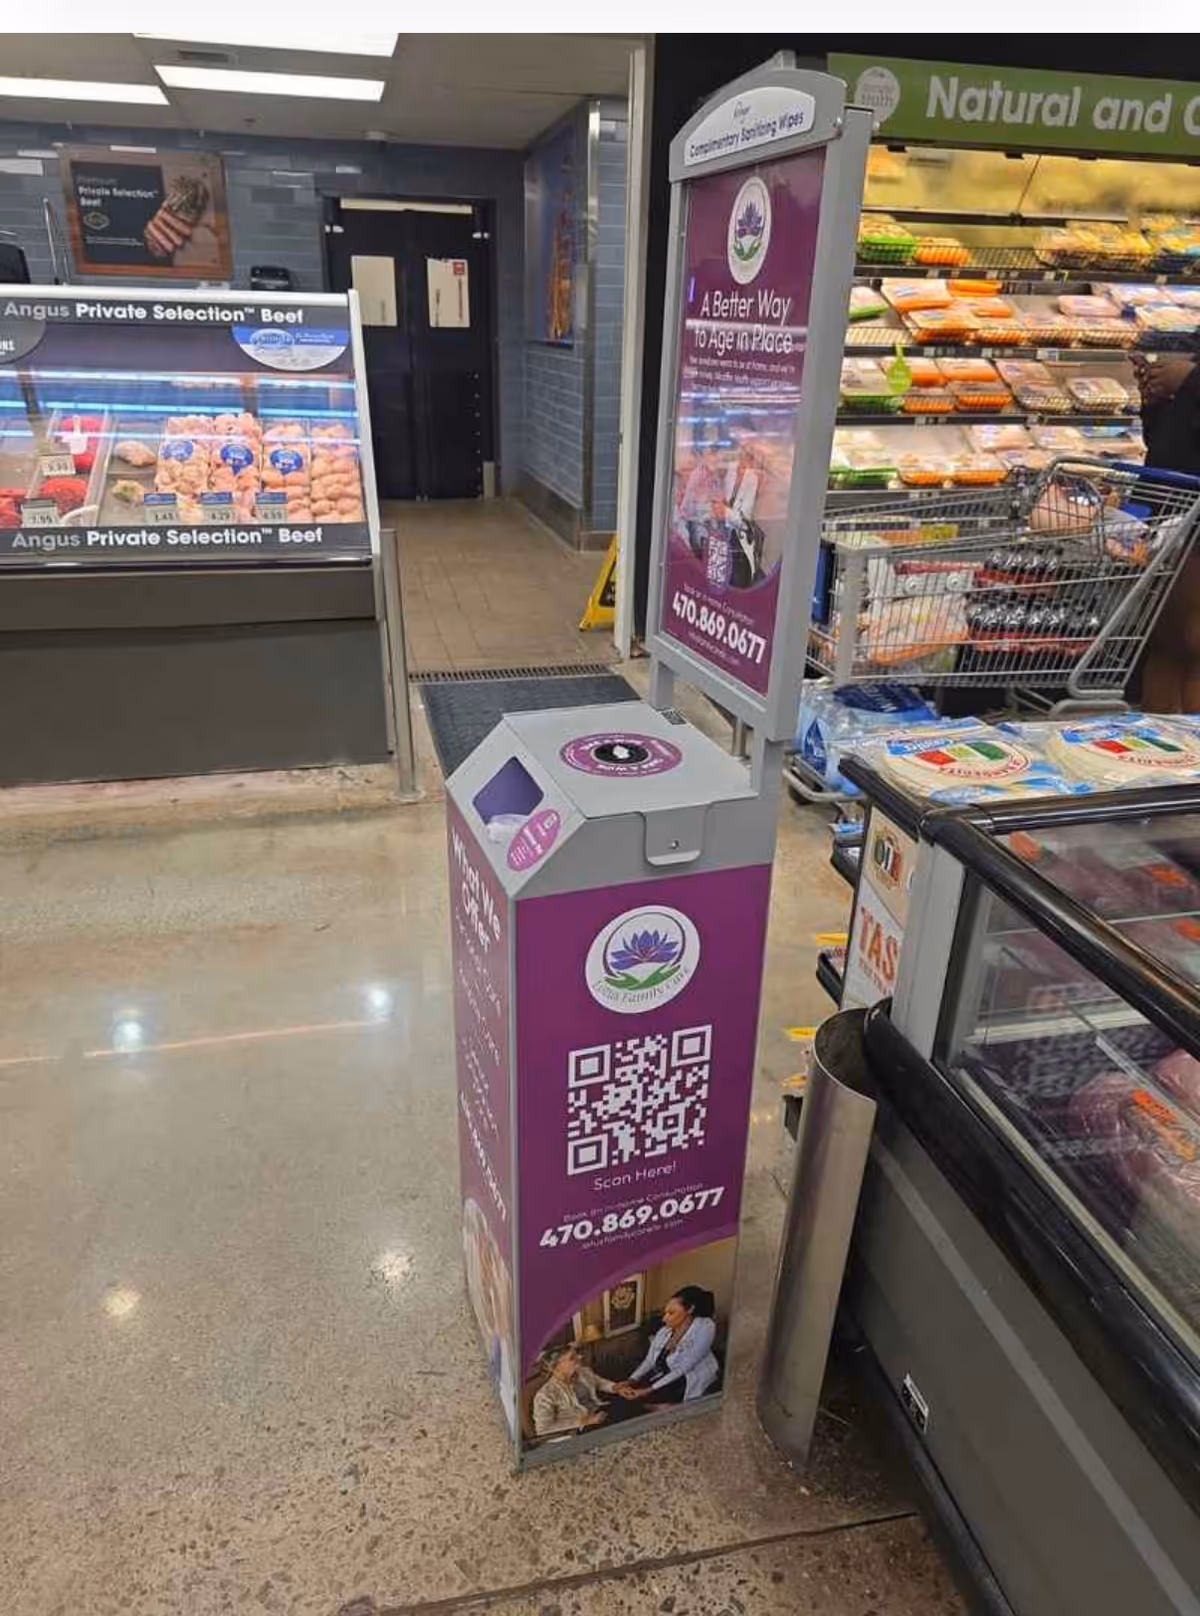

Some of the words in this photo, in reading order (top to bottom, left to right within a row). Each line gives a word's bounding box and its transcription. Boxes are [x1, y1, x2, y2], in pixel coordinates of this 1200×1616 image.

[926, 74, 1082, 128] Natural
[1092, 92, 1174, 134] and
[779, 111, 804, 131] Wipes
[78, 185, 111, 196] Private
[80, 196, 102, 207] Beef
[4, 301, 70, 320] Angus
[76, 302, 147, 321] Private
[261, 308, 304, 324] Beef
[700, 291, 711, 317] A
[713, 289, 753, 319] Better
[758, 288, 791, 327] Way
[708, 327, 734, 356] Age
[751, 323, 793, 354] Place
[11, 531, 82, 551] Angus
[87, 530, 161, 547] Private
[279, 527, 323, 544] Beef
[673, 589, 767, 664] 470.869.0677
[481, 880, 502, 943] We
[593, 1174, 631, 1191] Scan
[635, 1161, 677, 1181] Here!
[539, 1186, 725, 1248] 470.869.0677
